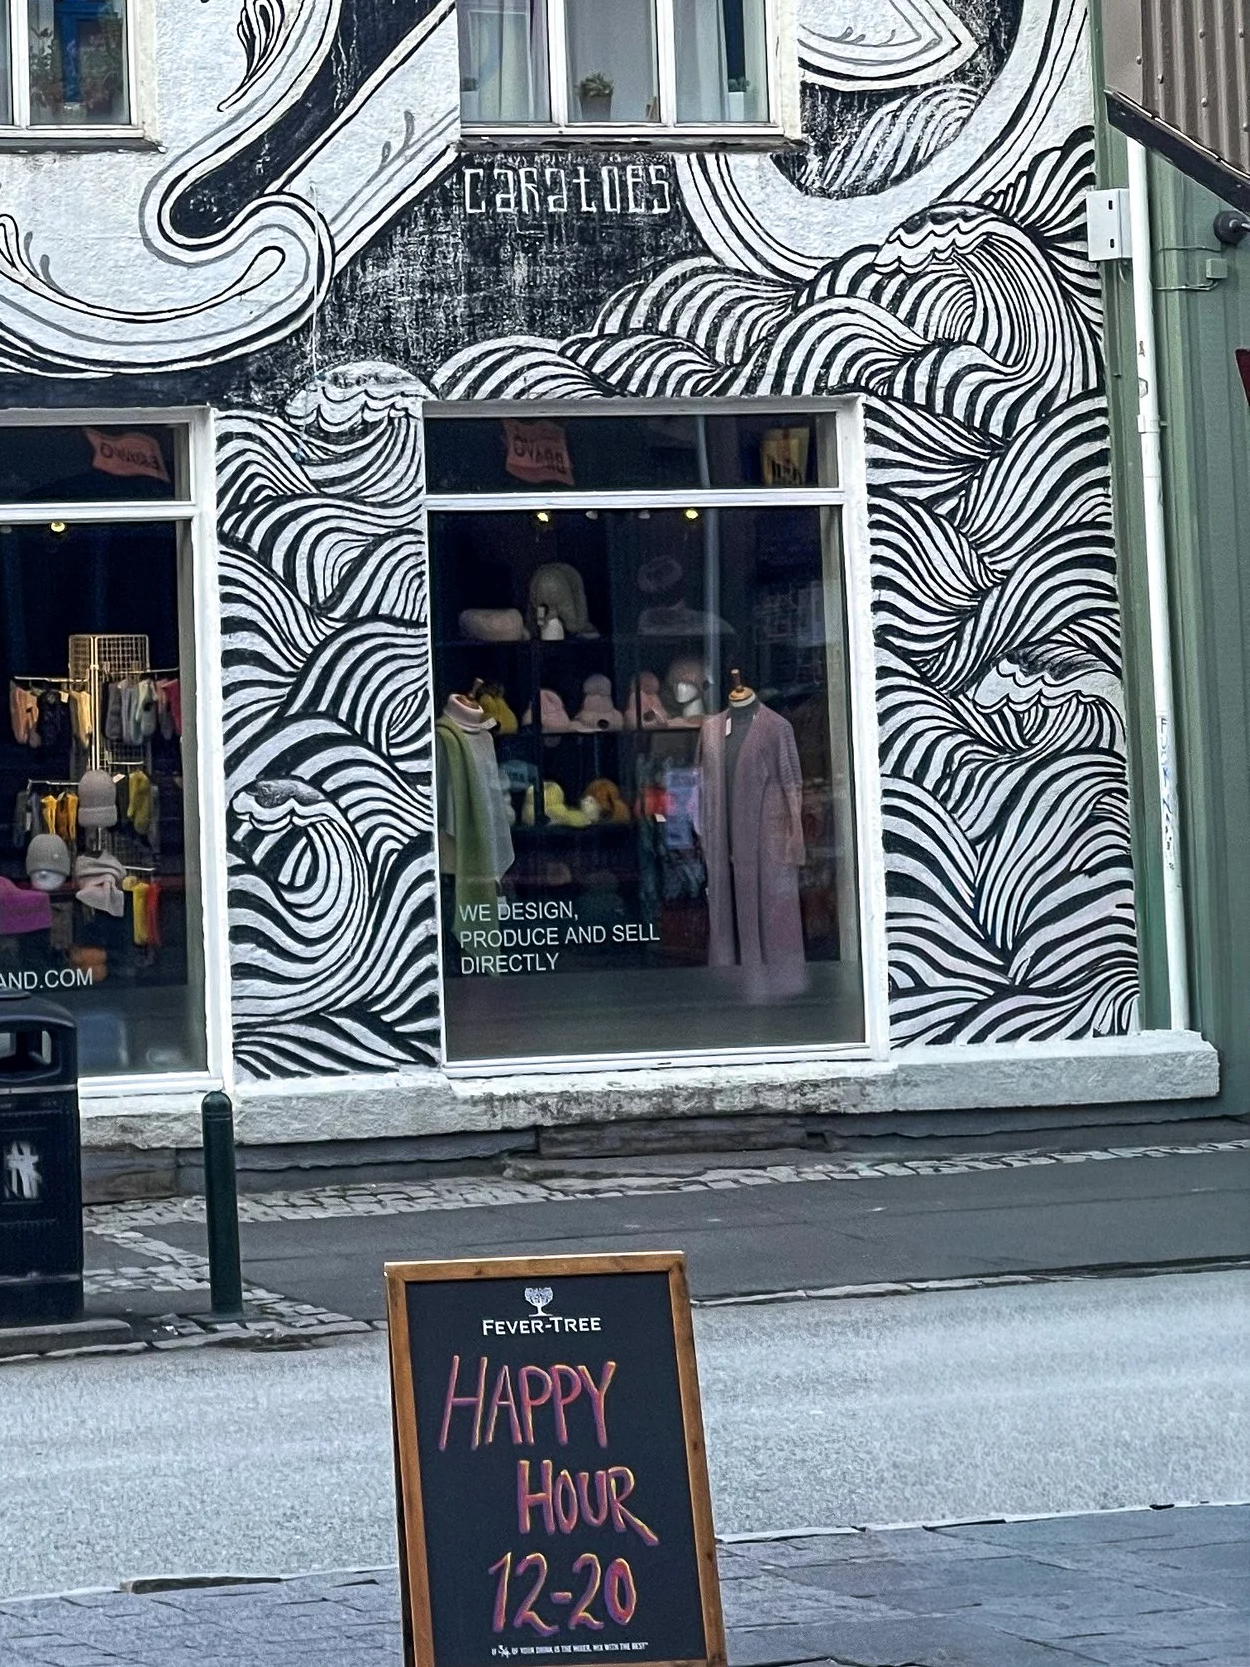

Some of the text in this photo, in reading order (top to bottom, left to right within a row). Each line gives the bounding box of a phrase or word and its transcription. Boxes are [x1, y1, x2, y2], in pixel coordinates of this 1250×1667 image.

[459, 901, 578, 922] WE DESIGN,
[460, 923, 660, 948] PRODUCE AND SELL
[461, 952, 560, 975] DIRECTLY
[482, 1316, 602, 1336] FEVER-TREE
[437, 1355, 617, 1451] HAPPY
[516, 1459, 660, 1546] HOUR
[487, 1551, 637, 1637] 12-20
